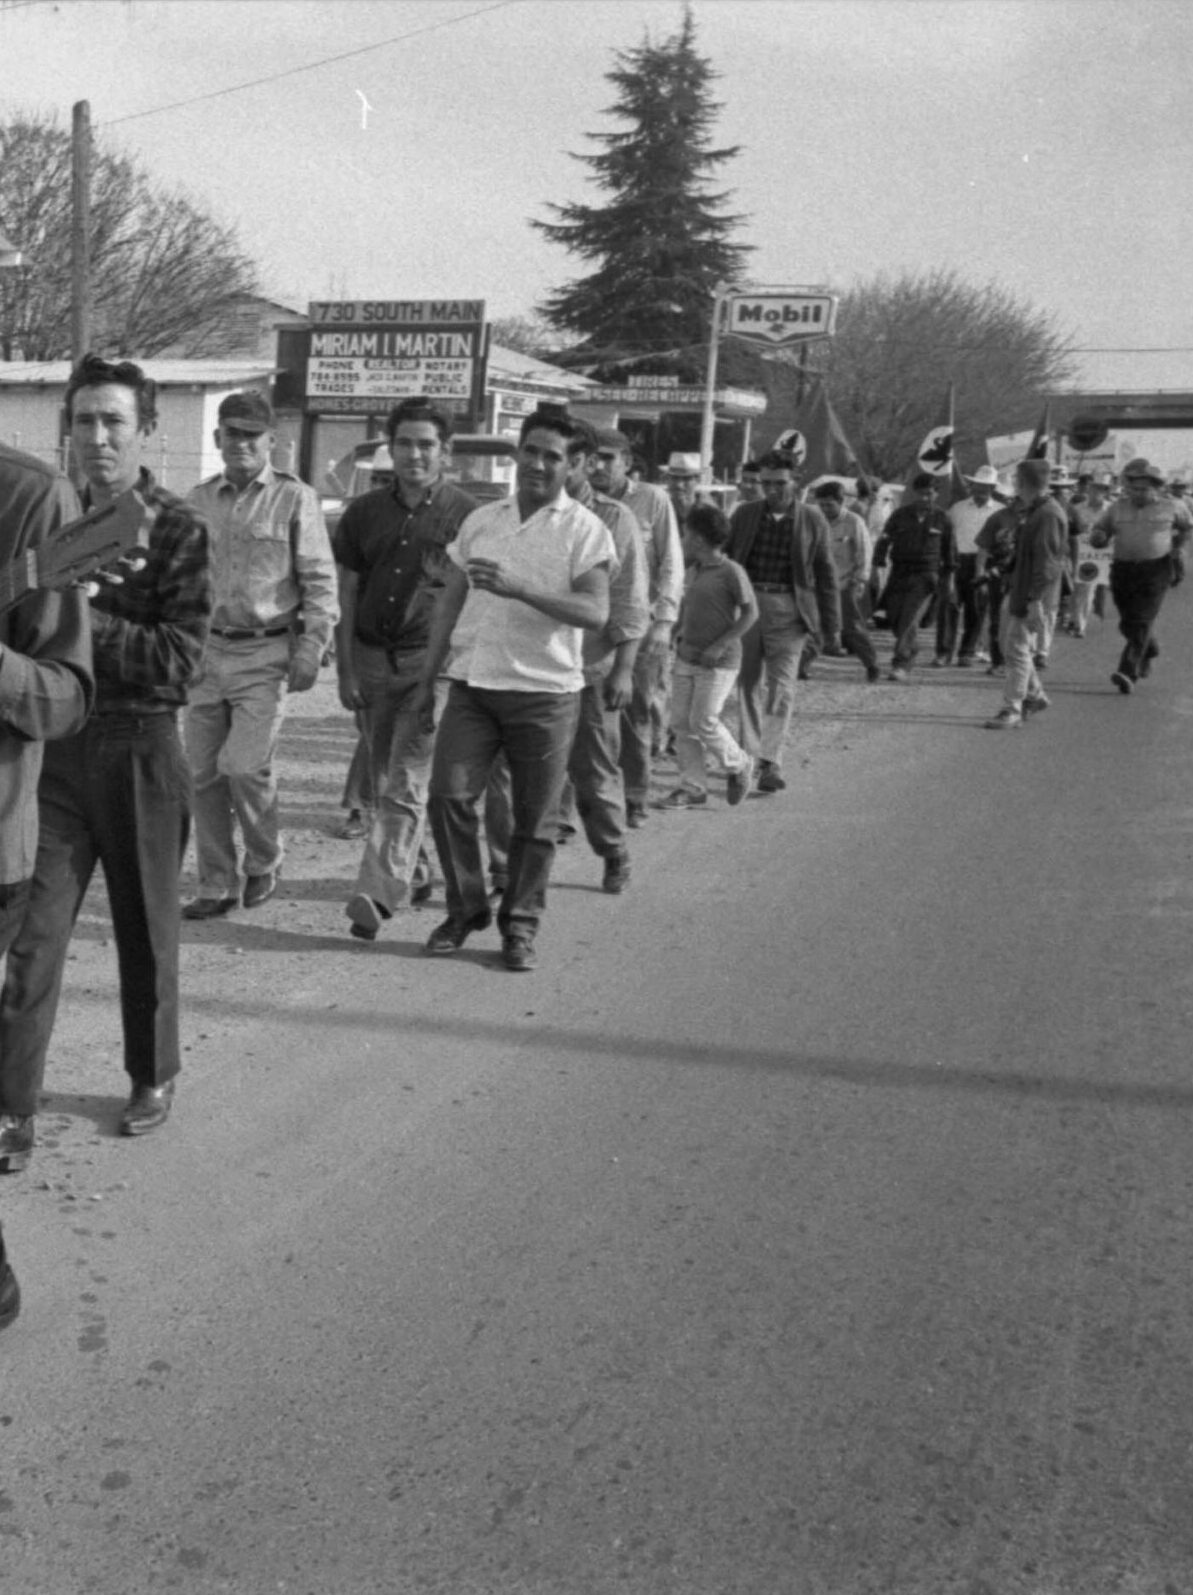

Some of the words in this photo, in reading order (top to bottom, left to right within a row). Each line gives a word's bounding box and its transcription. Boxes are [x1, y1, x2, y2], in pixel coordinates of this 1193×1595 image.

[318, 303, 355, 321] 730
[362, 303, 424, 321] SOUTH
[431, 302, 479, 321] MAIN
[738, 304, 823, 323] Mobil
[310, 333, 379, 356] MIRIAM
[394, 333, 473, 357] MARTIN
[318, 361, 355, 371] PHONE
[425, 361, 468, 371] NOTARY
[424, 373, 463, 383] PUBLIC
[315, 383, 355, 393] TRADES
[421, 385, 467, 395] RENTALS
